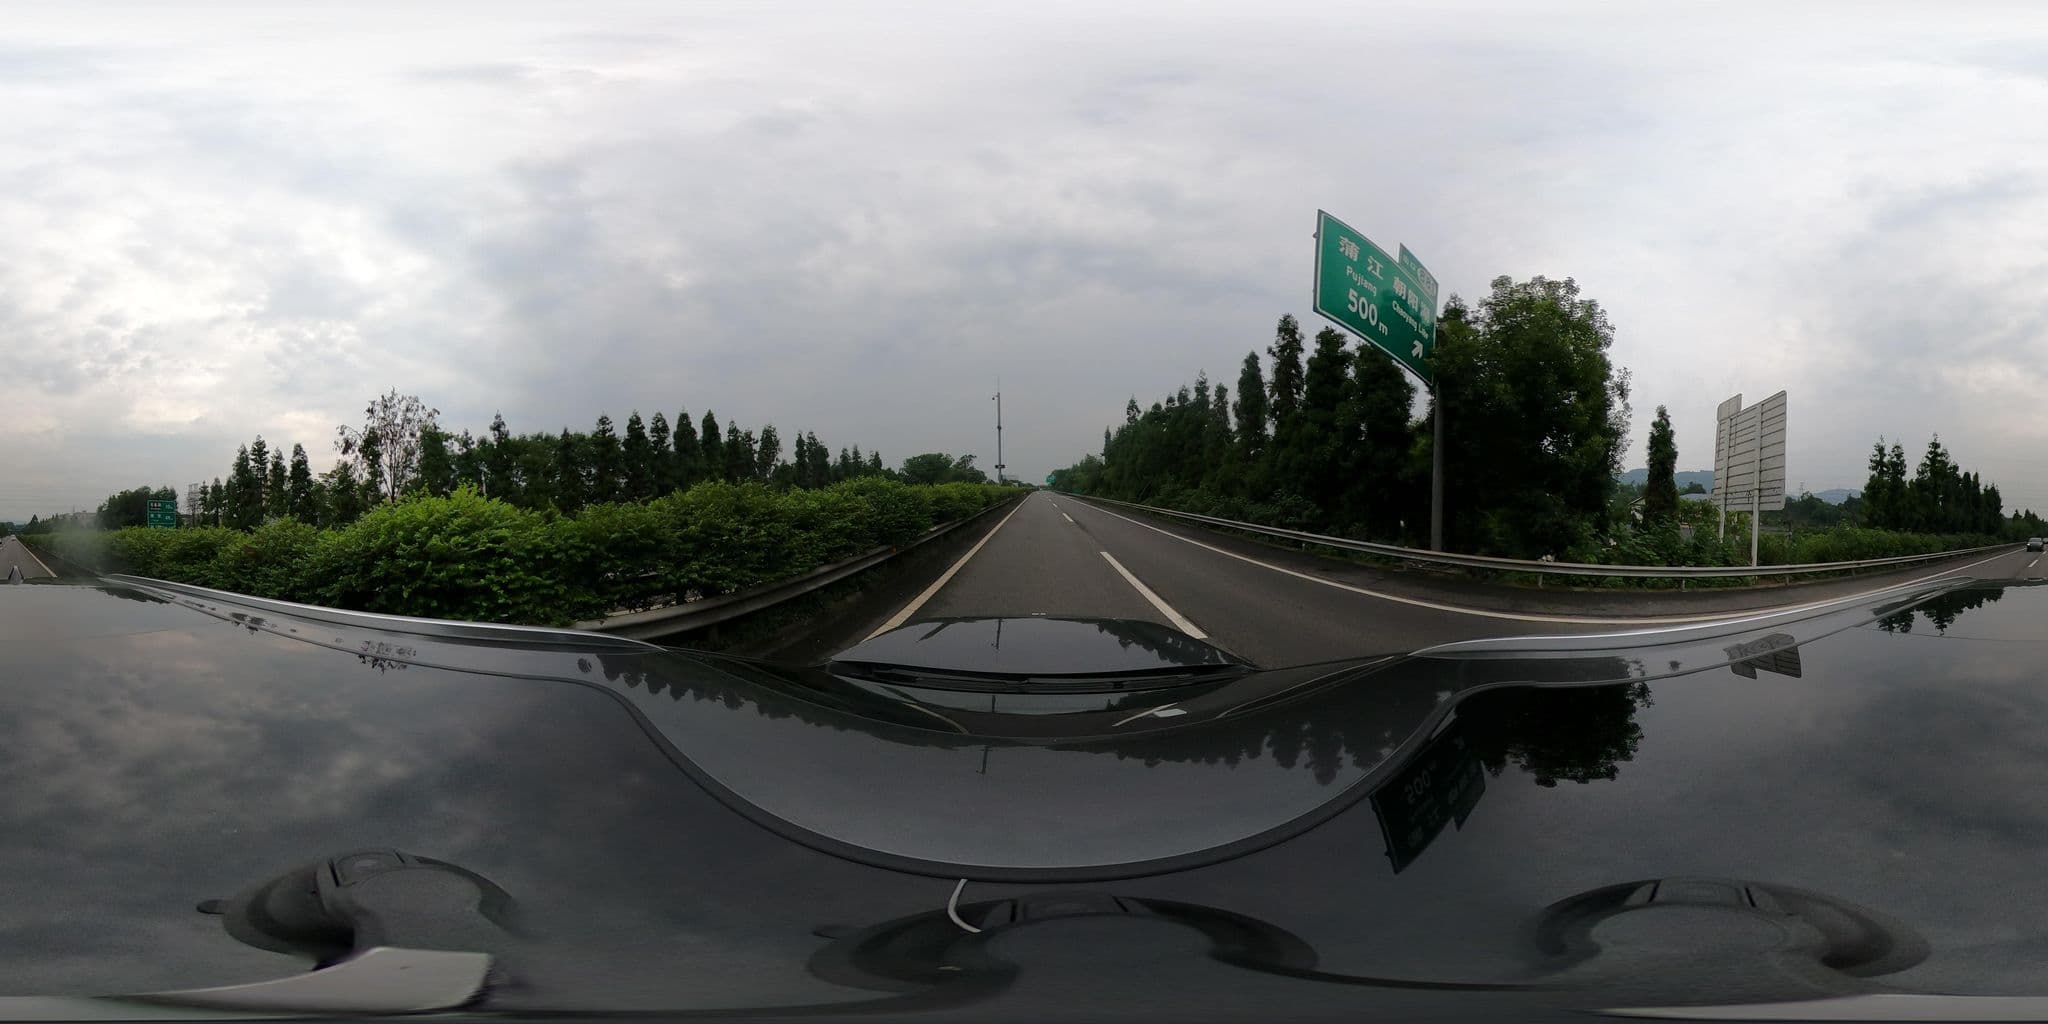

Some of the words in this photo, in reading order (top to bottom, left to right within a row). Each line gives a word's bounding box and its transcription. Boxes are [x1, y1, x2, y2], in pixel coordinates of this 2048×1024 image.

[1339, 235, 1384, 280] 蒲江
[1346, 265, 1377, 297] Pujiang
[1348, 288, 1378, 326] 500
[1379, 321, 1388, 336] m
